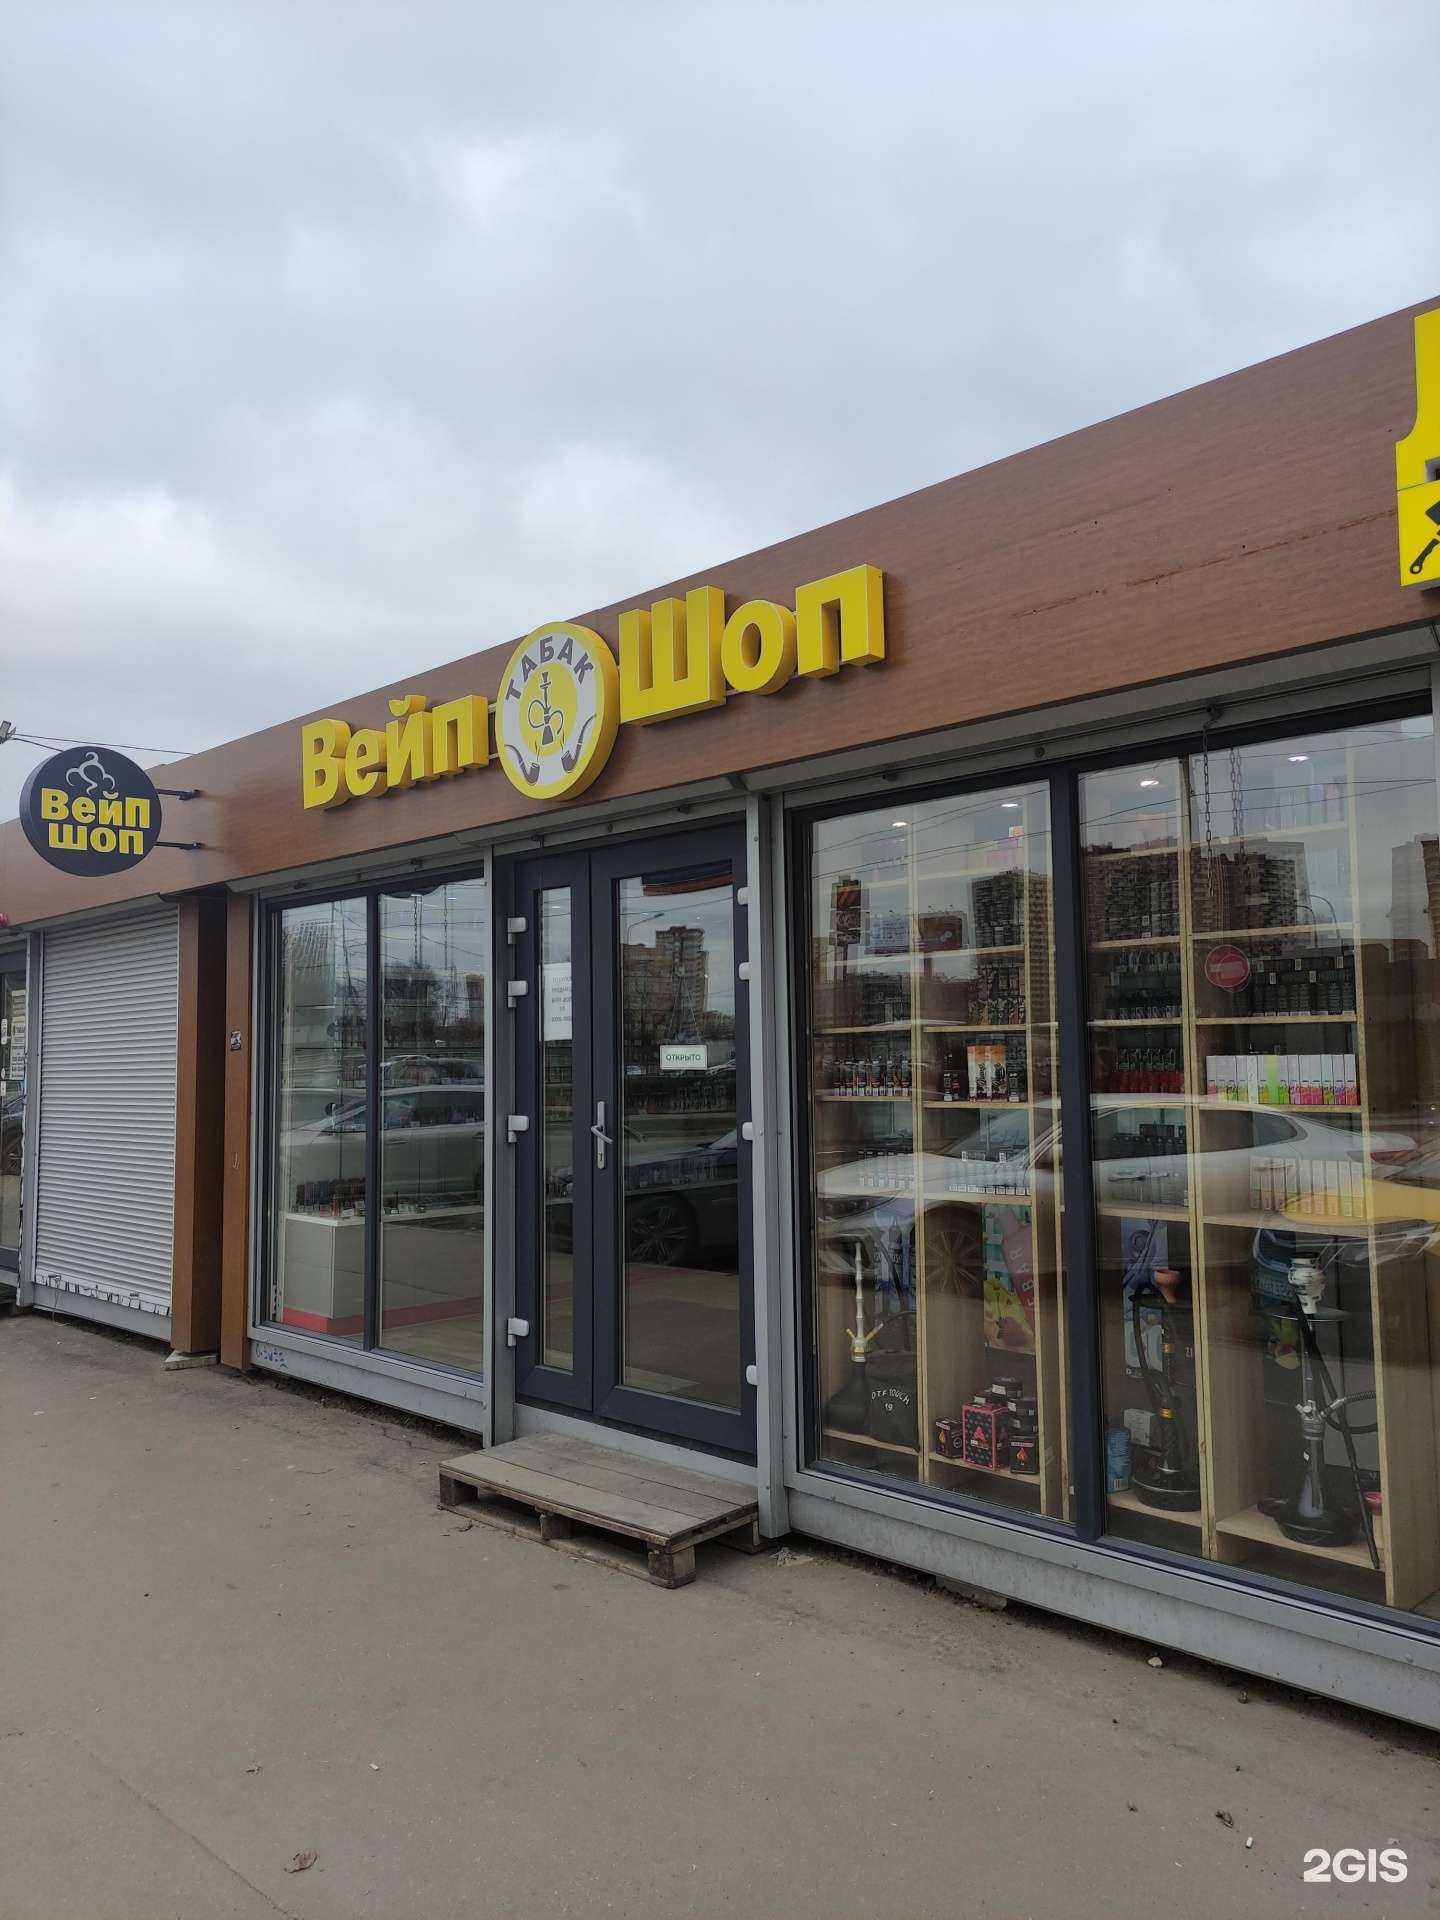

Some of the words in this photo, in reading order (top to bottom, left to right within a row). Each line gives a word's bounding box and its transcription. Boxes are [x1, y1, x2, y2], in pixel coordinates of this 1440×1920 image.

[302, 696, 488, 809] Вейп
[618, 563, 885, 726] Шоп
[505, 635, 594, 700] ТАБАК
[41, 788, 150, 829] Вейп
[665, 1053, 702, 1062] ОТКРЫТО
